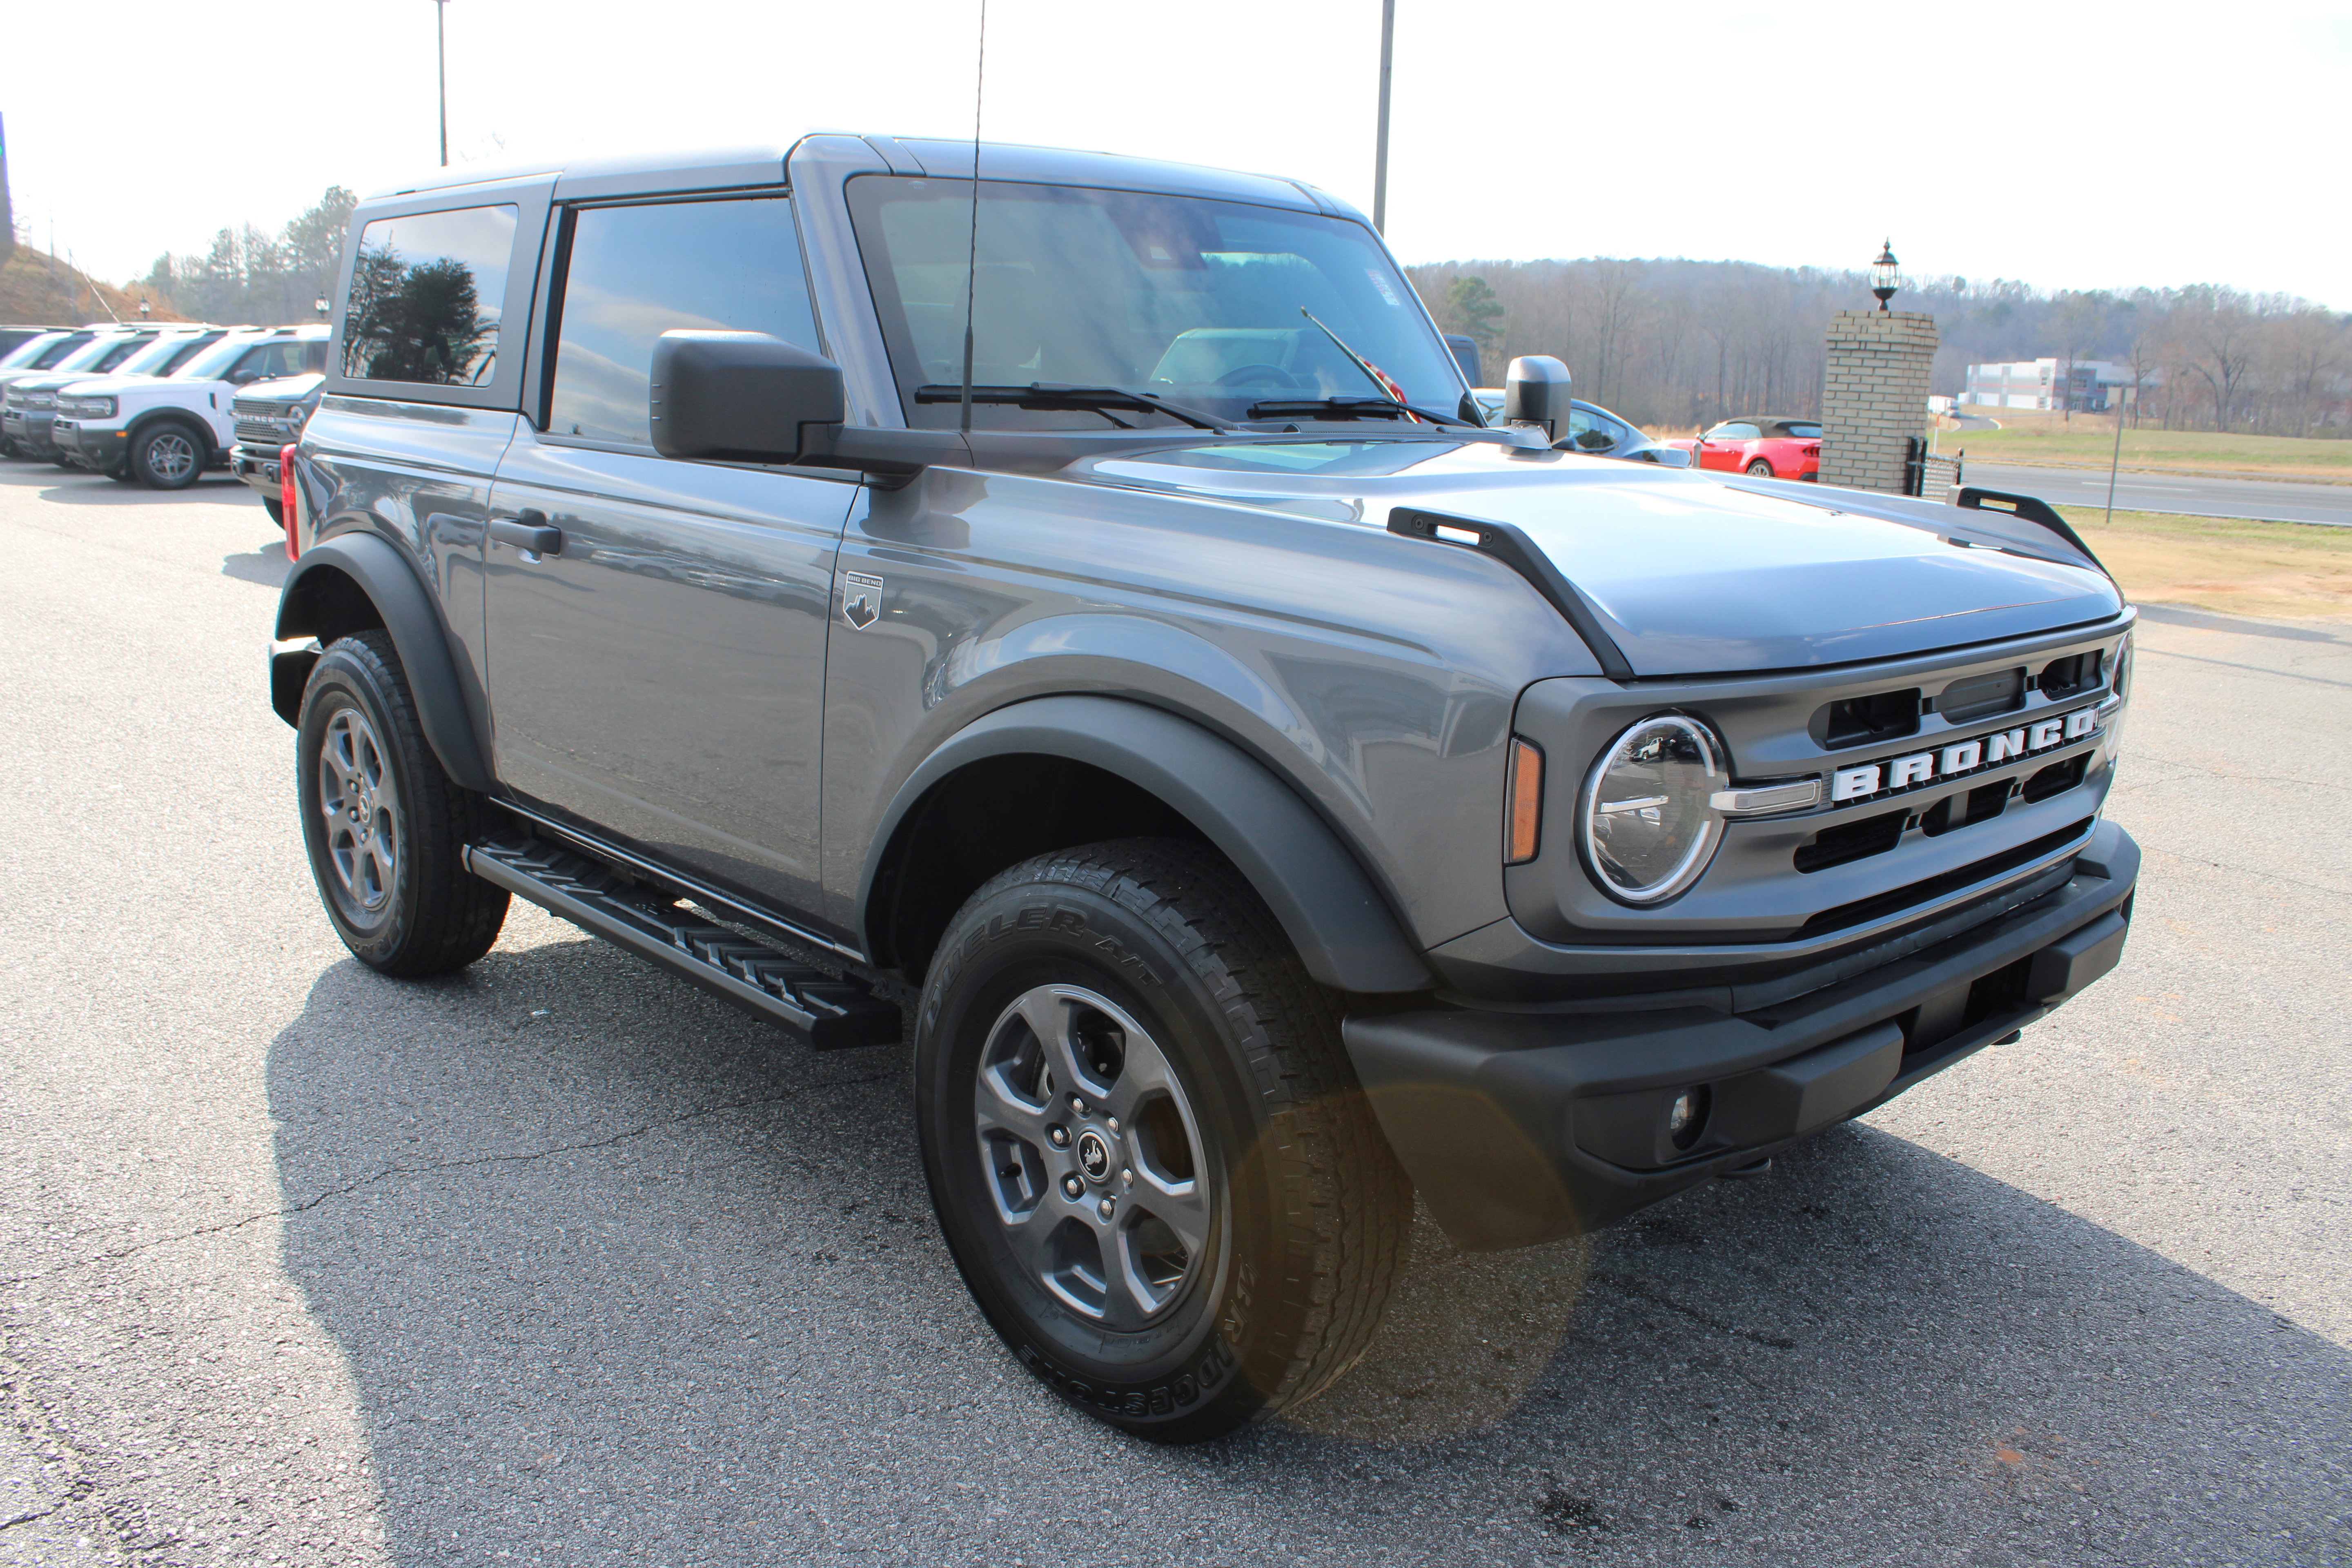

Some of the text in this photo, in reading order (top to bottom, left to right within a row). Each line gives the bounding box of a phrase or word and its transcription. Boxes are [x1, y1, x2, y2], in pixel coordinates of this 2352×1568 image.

[1831, 708, 2095, 802] BRONCO
[925, 902, 1164, 1038] DUELER A/T
[1017, 1253, 1259, 1418] BRIDGESTONE
